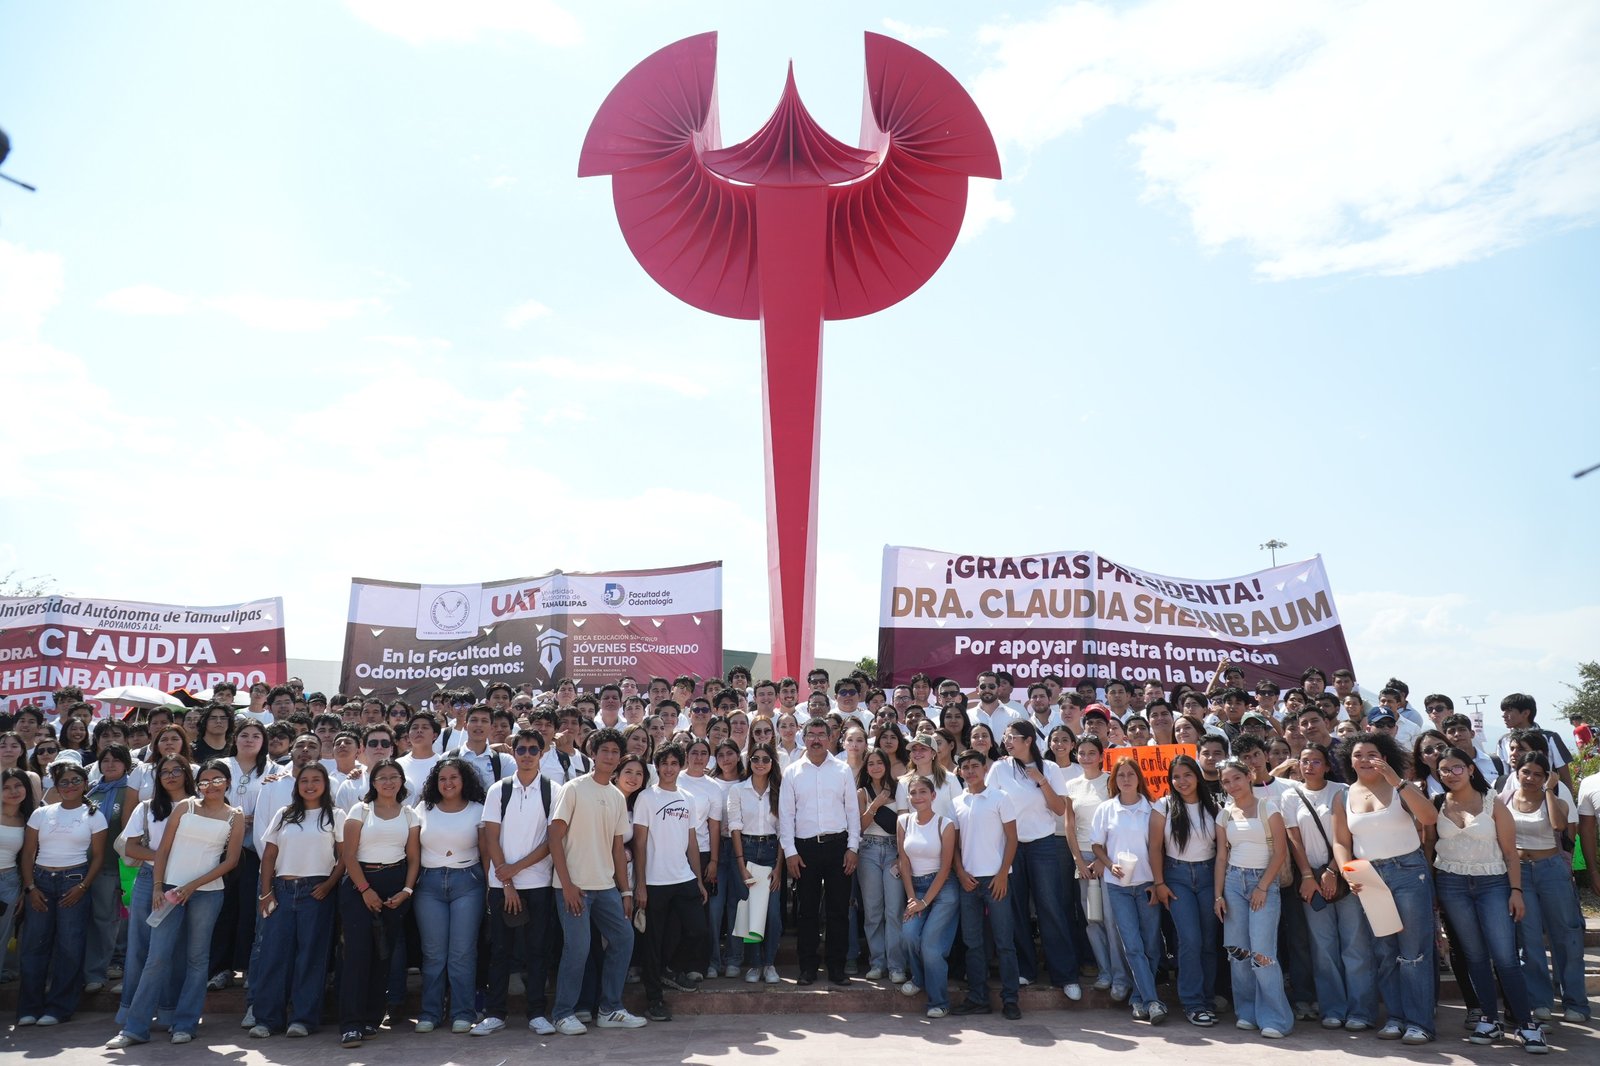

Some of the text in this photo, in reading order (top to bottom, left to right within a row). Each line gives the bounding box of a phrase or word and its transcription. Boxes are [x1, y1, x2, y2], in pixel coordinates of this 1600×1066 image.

[946, 555, 1091, 584] ¡GRACIAS
[491, 587, 540, 617] UAT
[541, 600, 587, 608] TAMAULIPAS
[628, 590, 660, 599] Facultad
[628, 597, 673, 606] Odontología
[83, 603, 160, 622] Autónoma
[163, 611, 180, 622] de
[184, 609, 262, 625] Tamaulipas
[891, 586, 1332, 637] DRA. CLAUDIA SHEINBAUM
[98, 620, 162, 631] APOYAMOS A LA:
[0, 628, 217, 664] DRA. CLAUDIA
[383, 642, 522, 663] En la Facultad de
[573, 641, 699, 655] JÓVENES ESCRIBIENDO
[955, 635, 1279, 665] Por apoyar nuestra formación
[355, 661, 525, 681] Odontología somos:
[573, 656, 638, 666] EL FUTURO
[0, 665, 266, 694] HEINBAUM PARDO
[1121, 666, 1161, 681] con
[1165, 665, 1186, 683] la
[1189, 666, 1226, 684] bec
